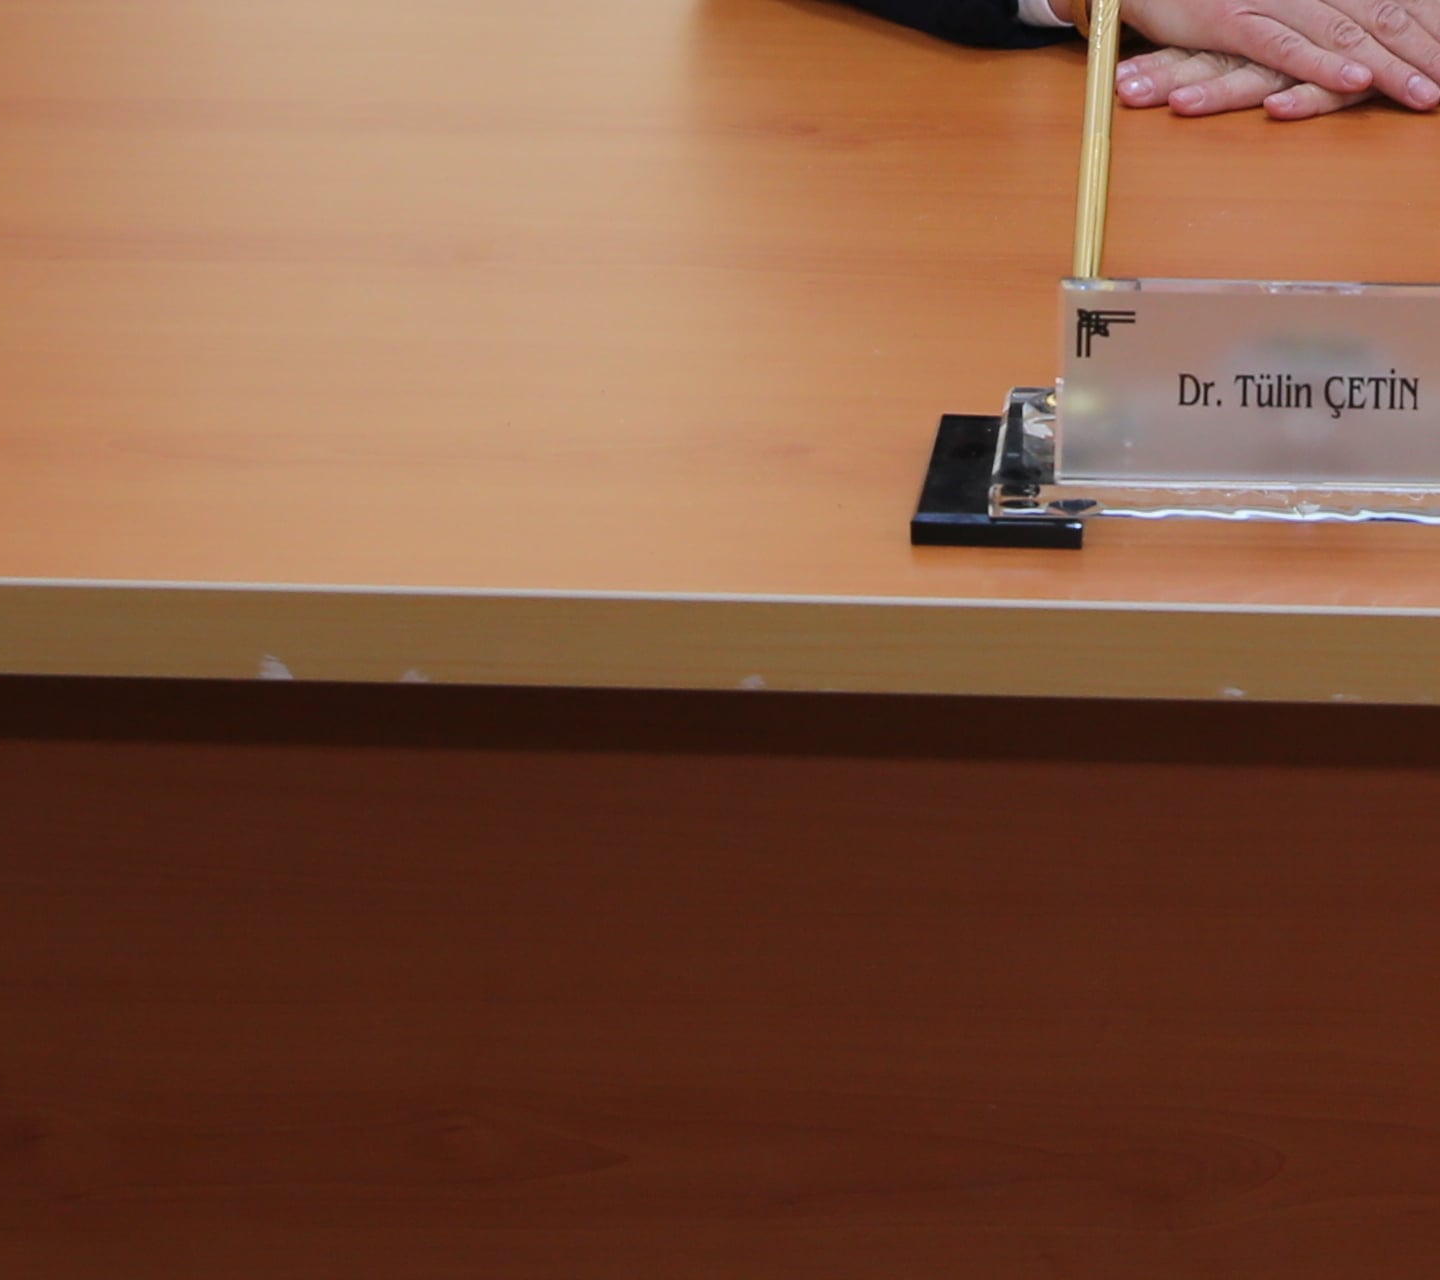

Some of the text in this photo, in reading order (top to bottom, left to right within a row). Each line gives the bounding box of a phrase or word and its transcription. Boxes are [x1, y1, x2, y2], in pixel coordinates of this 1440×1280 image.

[1177, 368, 1420, 419] Dr. Tülin ÇETİN
